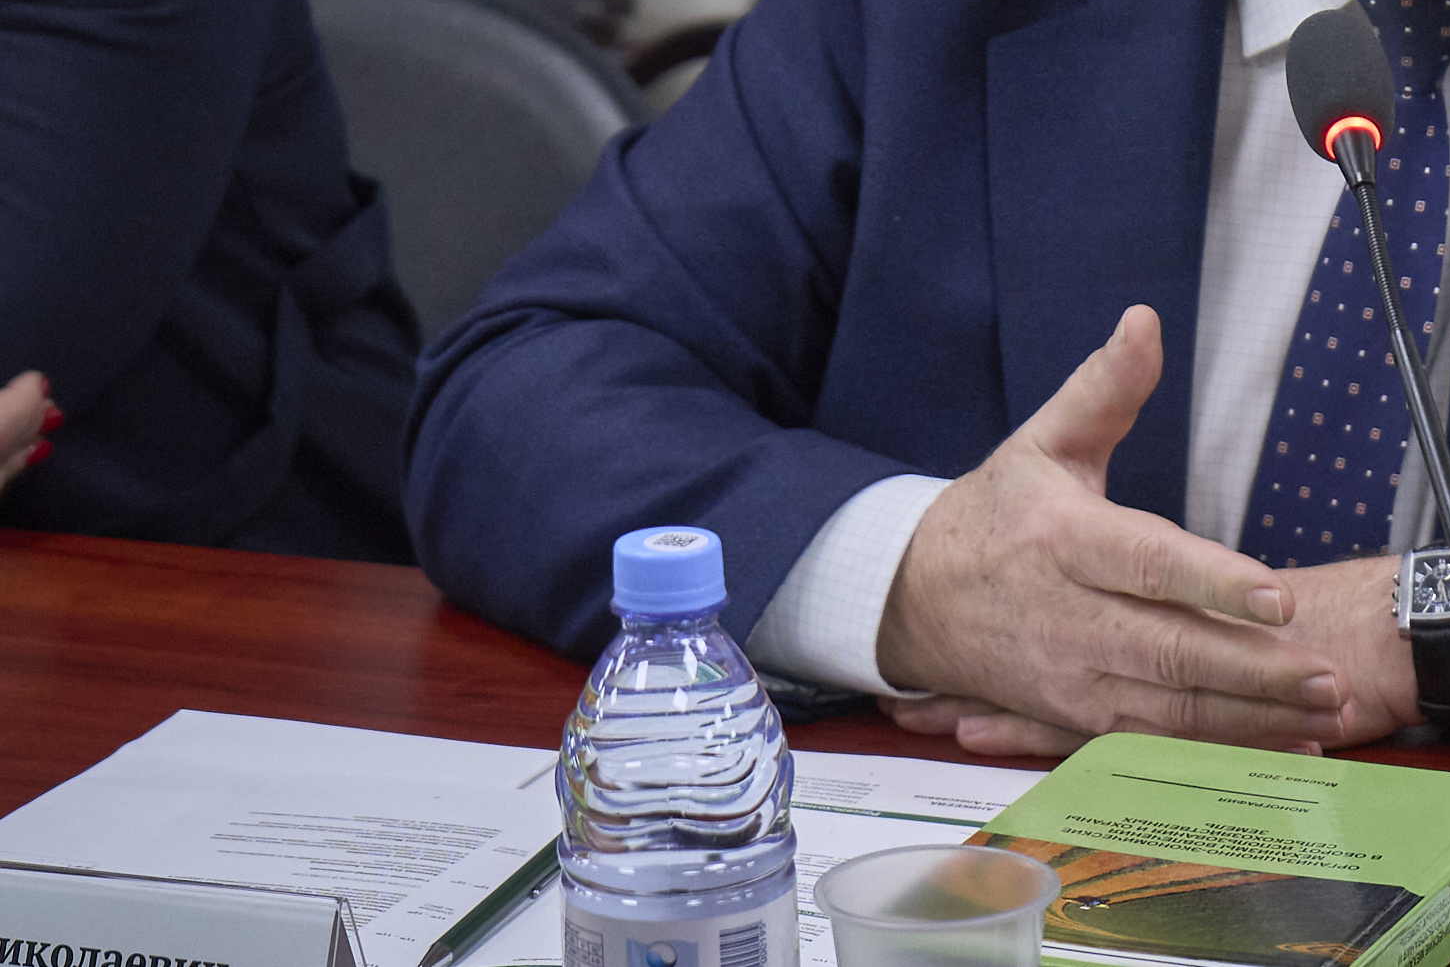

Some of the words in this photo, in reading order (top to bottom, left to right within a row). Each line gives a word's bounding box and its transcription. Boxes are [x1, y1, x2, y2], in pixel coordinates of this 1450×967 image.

[1248, 772, 1282, 781] 2020
[1285, 776, 1338, 788] Москва
[1218, 797, 1310, 813] МОНОГРАФИЯ
[1065, 814, 1133, 829] ОХРАНЫ
[1205, 822, 1269, 835] ЗЕМЕЛЬ
[1108, 828, 1217, 848] ВОВЛЕЧЕНИЯ
[1123, 817, 1338, 849] СЕЛЬСКОХОЗЯЙСТВЕННЫХ
[1151, 828, 1293, 851] ИСПОЛЬЗОВАНИЯ
[1061, 827, 1360, 871] ОРГАНИЗАЦИОННО-ЭКОНОМИЧЕСКИЕ
[1220, 843, 1325, 861] МЕХАНИЗМЫ
[1300, 845, 1366, 859] ОБОРОТ,
[0, 937, 229, 967] иколае
